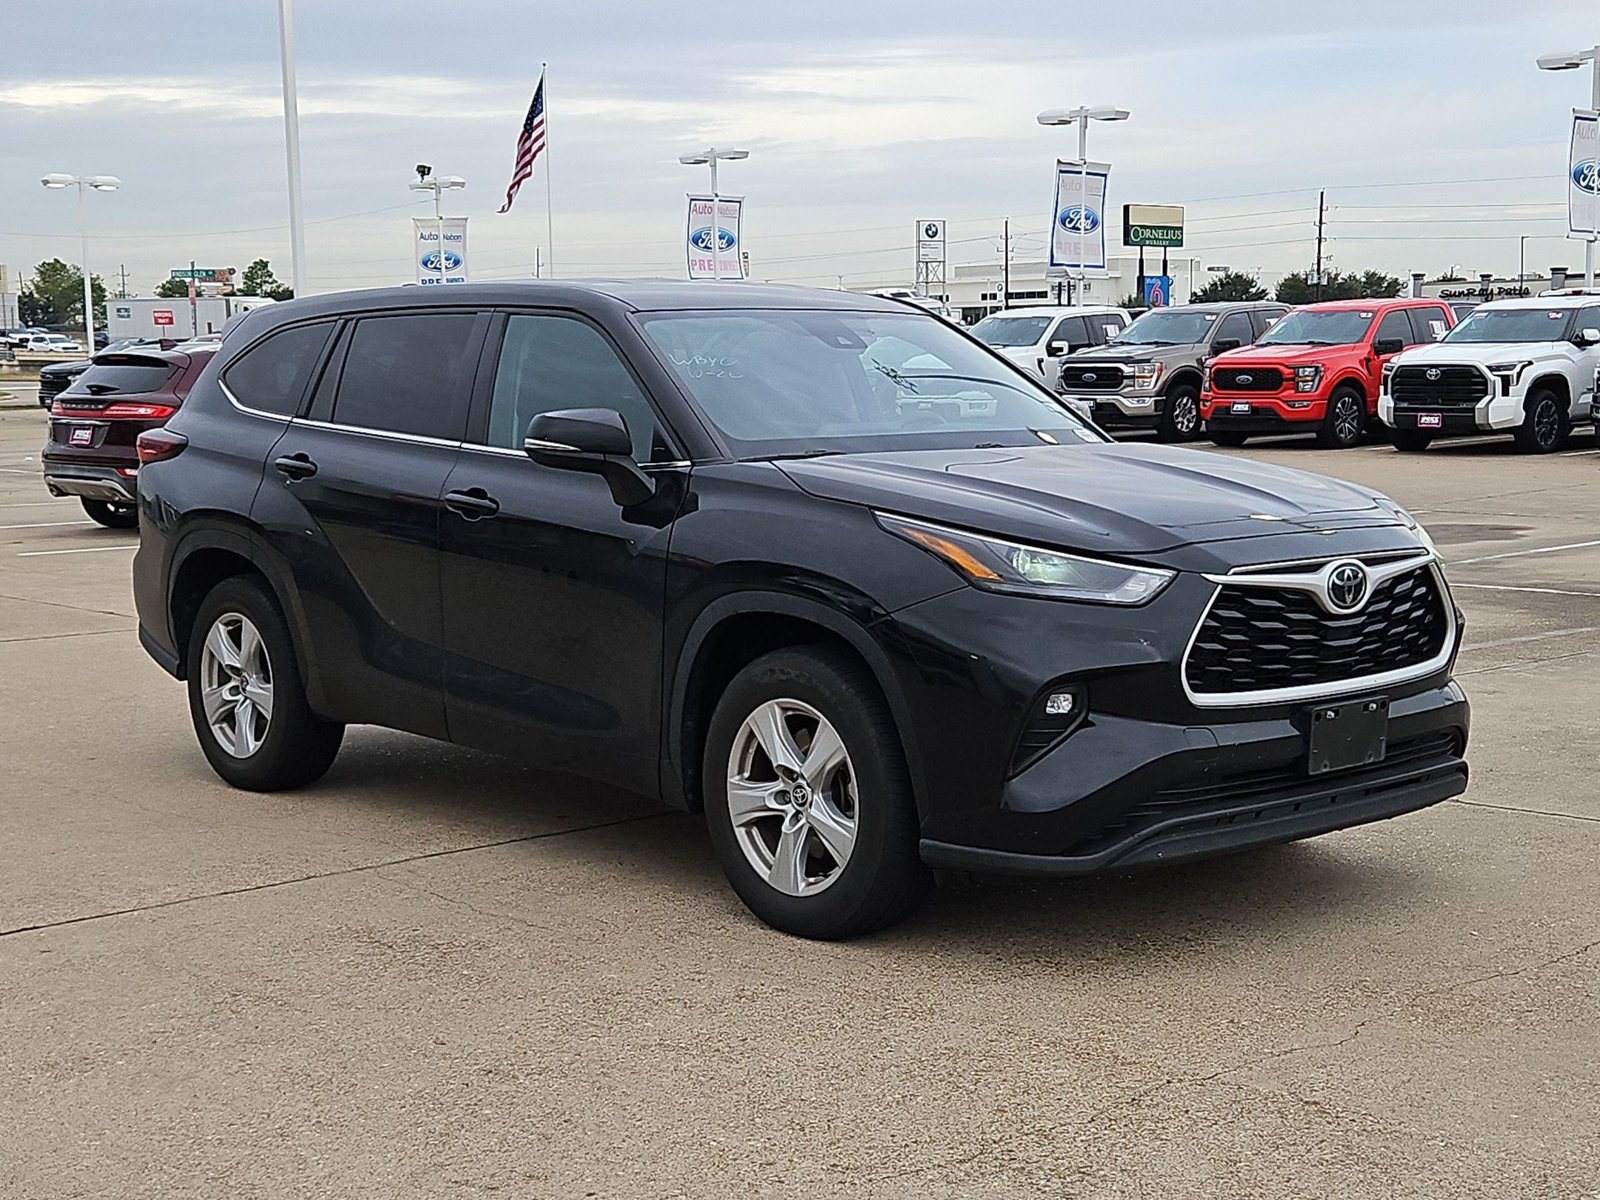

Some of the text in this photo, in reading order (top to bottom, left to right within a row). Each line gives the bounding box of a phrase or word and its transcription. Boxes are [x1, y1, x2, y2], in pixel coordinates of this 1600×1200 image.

[692, 203, 713, 215] Auto
[419, 231, 439, 241] Auto
[698, 230, 729, 249] Fod
[1131, 226, 1182, 242] CORNELIUS
[427, 253, 455, 269] Fod
[691, 260, 714, 271] PRE
